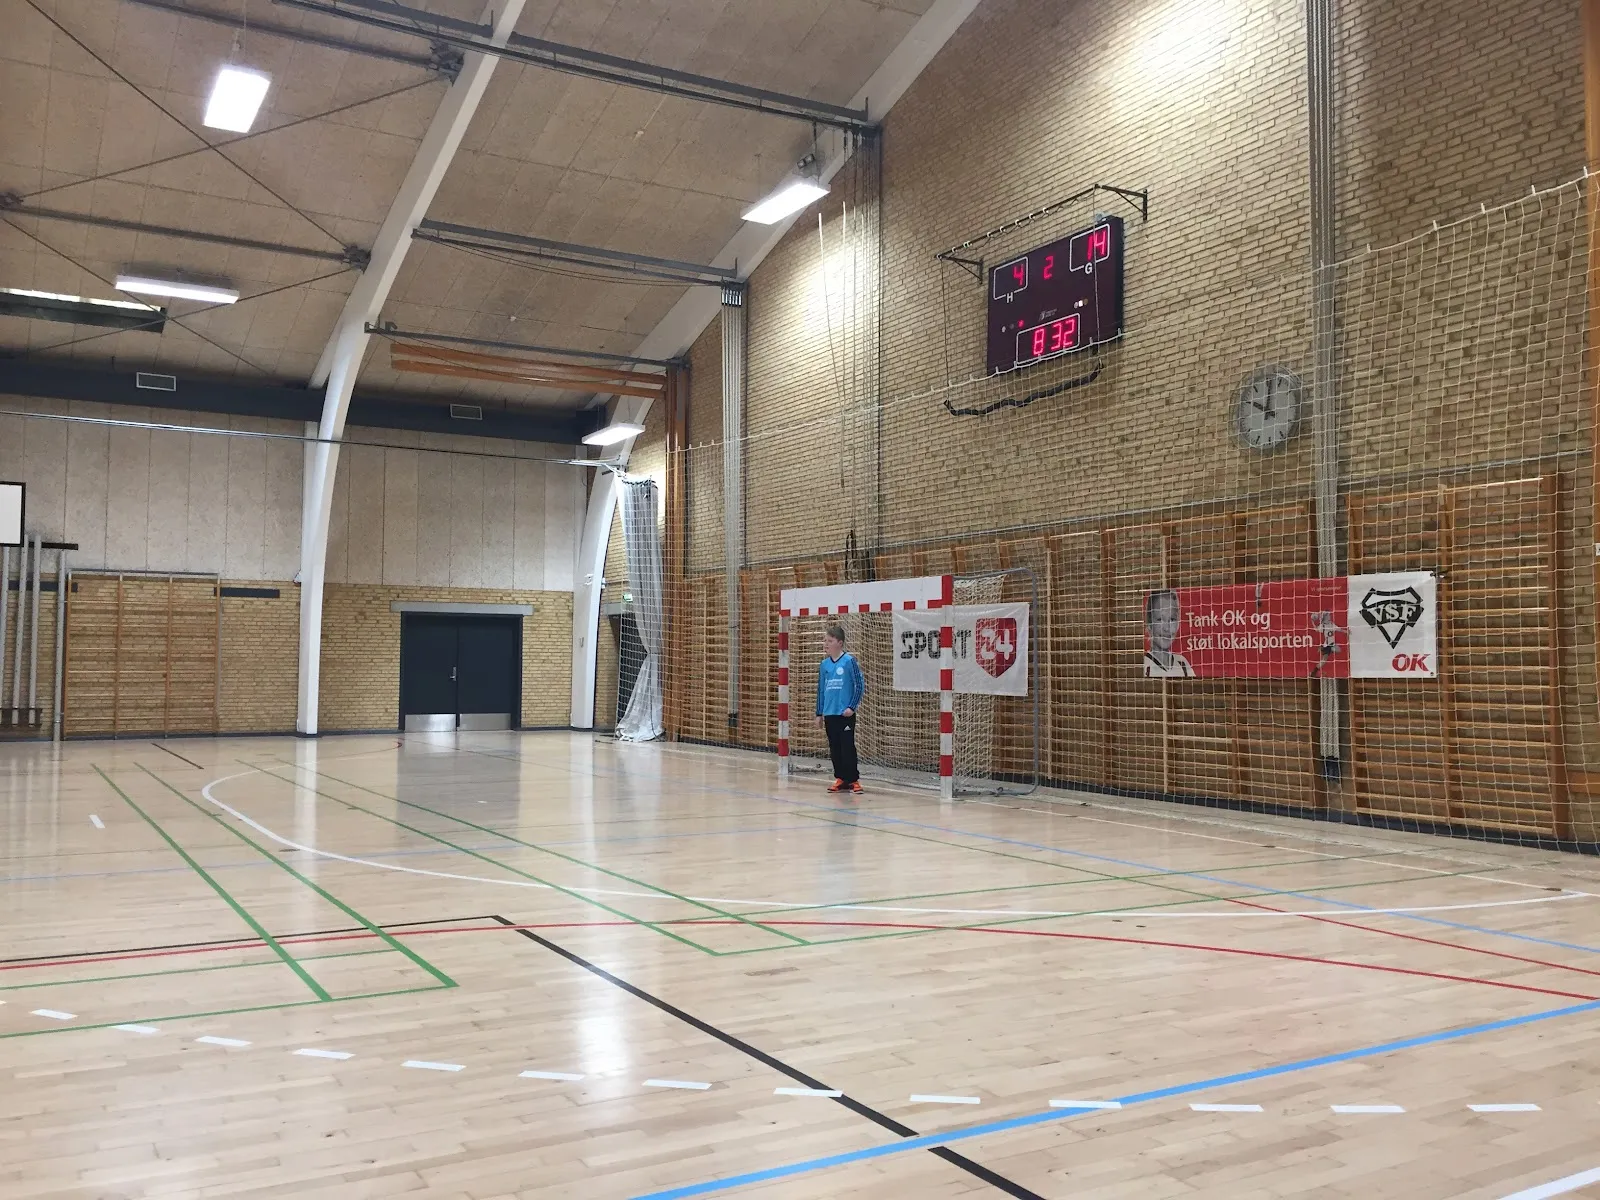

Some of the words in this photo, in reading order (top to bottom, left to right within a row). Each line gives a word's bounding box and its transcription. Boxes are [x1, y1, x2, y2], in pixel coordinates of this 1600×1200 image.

[1087, 230, 1106, 260] 14
[1013, 263, 1024, 286] 4
[1043, 255, 1054, 280] 2
[1084, 262, 1093, 274] G
[1006, 292, 1014, 303] H
[1185, 610, 1218, 628] Tank
[1221, 609, 1246, 627] OK
[1250, 610, 1270, 630] og
[1370, 603, 1417, 624] VSF
[980, 628, 1014, 661] 24
[1186, 635, 1213, 650] støt
[1217, 632, 1313, 654] lokalsporten
[1391, 653, 1431, 673] OK
